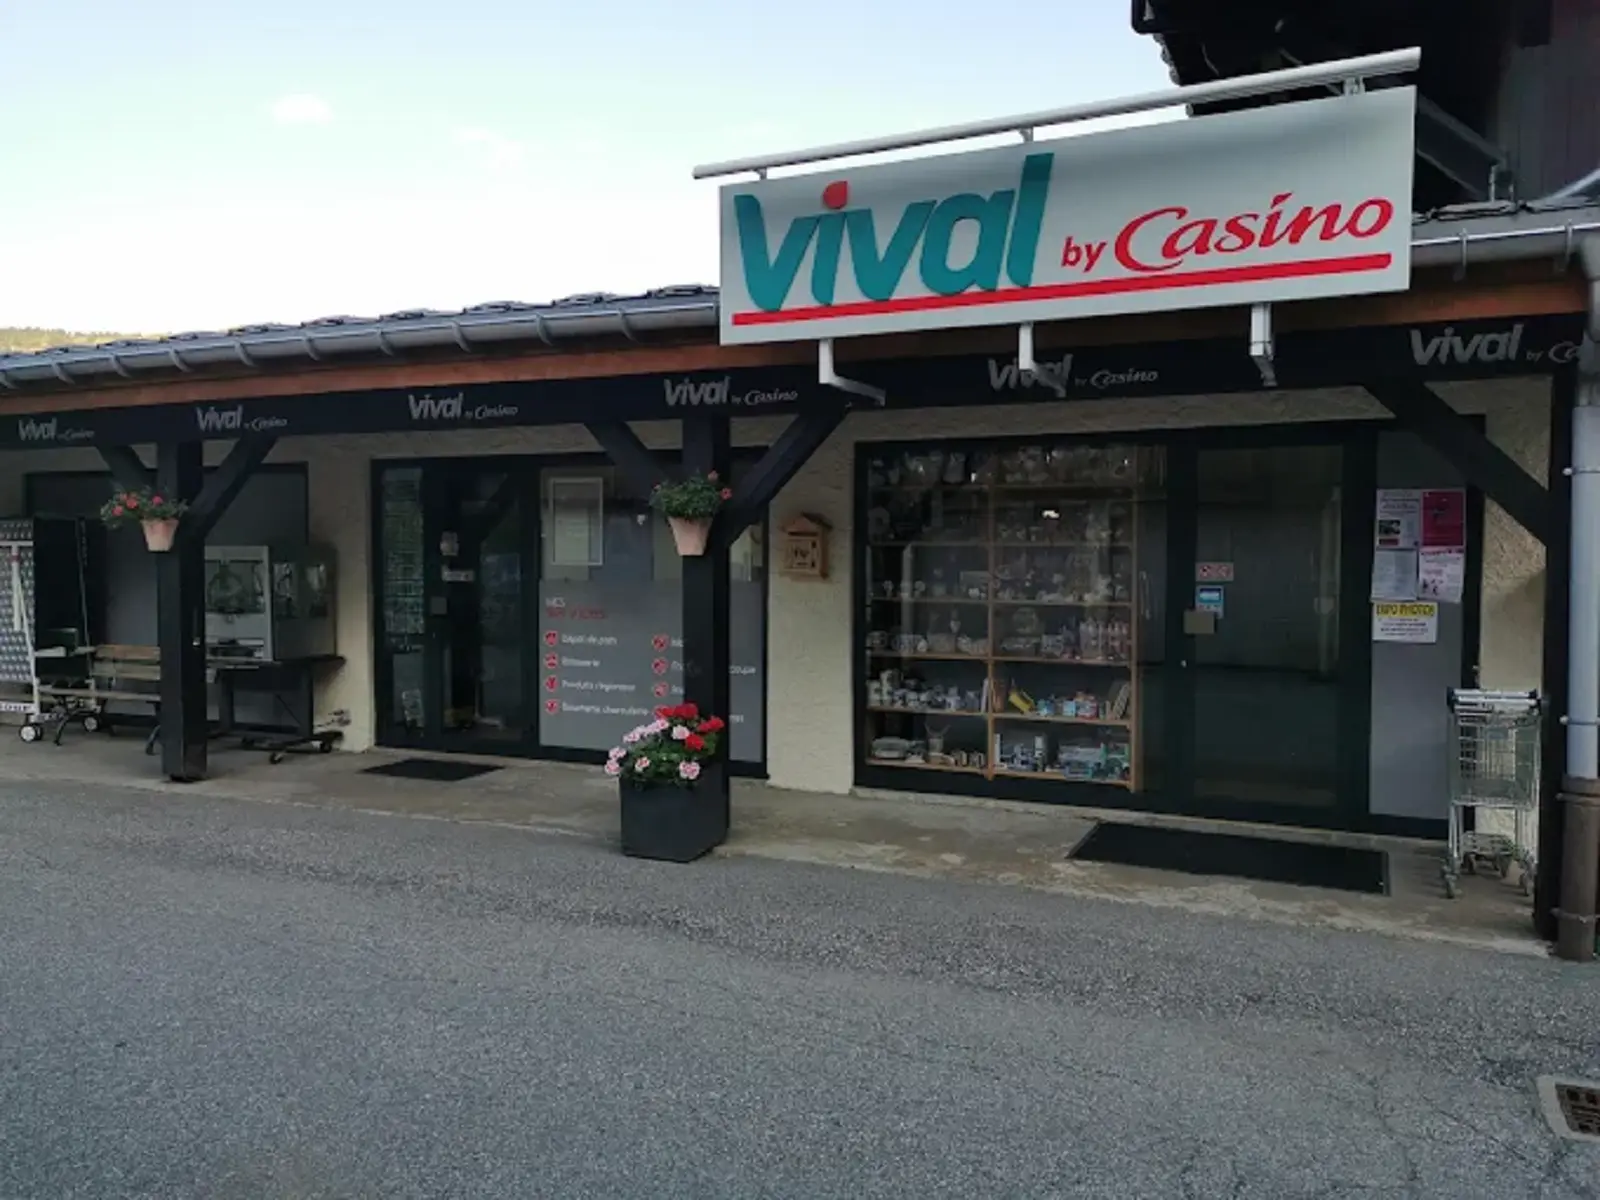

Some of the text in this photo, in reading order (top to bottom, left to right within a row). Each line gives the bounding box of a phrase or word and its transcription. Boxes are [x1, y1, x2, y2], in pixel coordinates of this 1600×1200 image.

[1061, 236, 1107, 272] by
[1114, 191, 1393, 272] Casino
[1410, 323, 1525, 366] Vival
[1526, 350, 1544, 363] by
[663, 375, 732, 406] Vival
[743, 387, 799, 406] Casino
[1090, 367, 1159, 389] Casino
[195, 403, 244, 432] Vival
[407, 391, 464, 420] Vival
